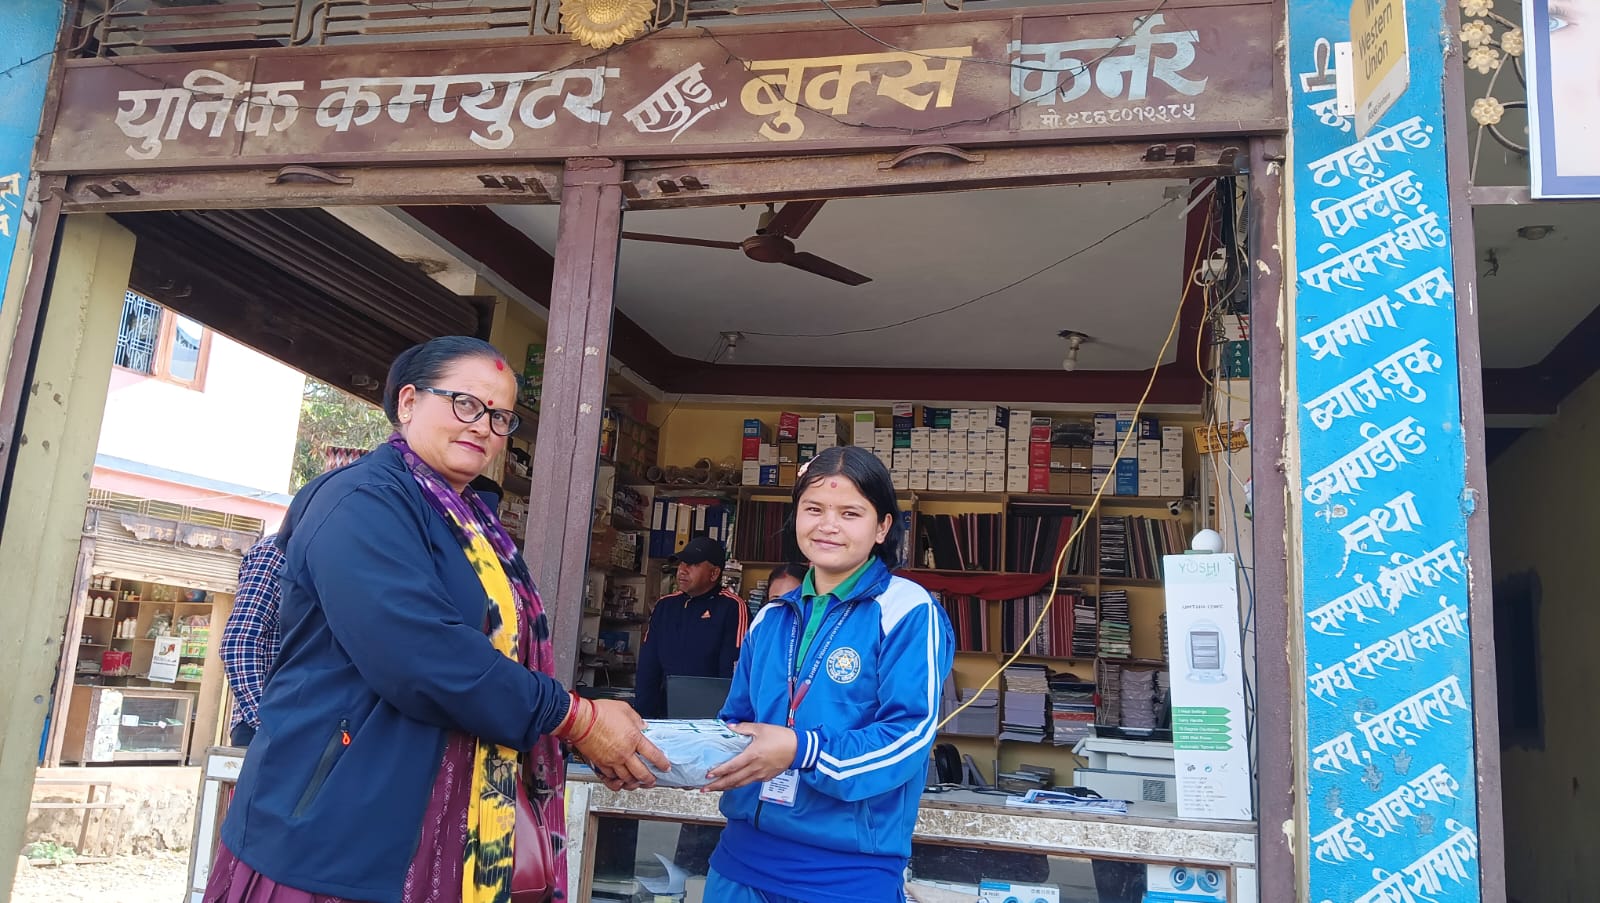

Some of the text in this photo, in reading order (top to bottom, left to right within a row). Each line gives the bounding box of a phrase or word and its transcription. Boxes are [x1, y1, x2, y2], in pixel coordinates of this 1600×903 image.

[1358, 2, 1393, 60] Western
[1365, 39, 1389, 80] Union
[115, 68, 304, 160] युनिक
[315, 67, 620, 150] कम्प्युटर
[741, 46, 973, 141] बुक्स
[1008, 13, 1209, 105] कर्नर
[1040, 109, 1063, 127] मो.
